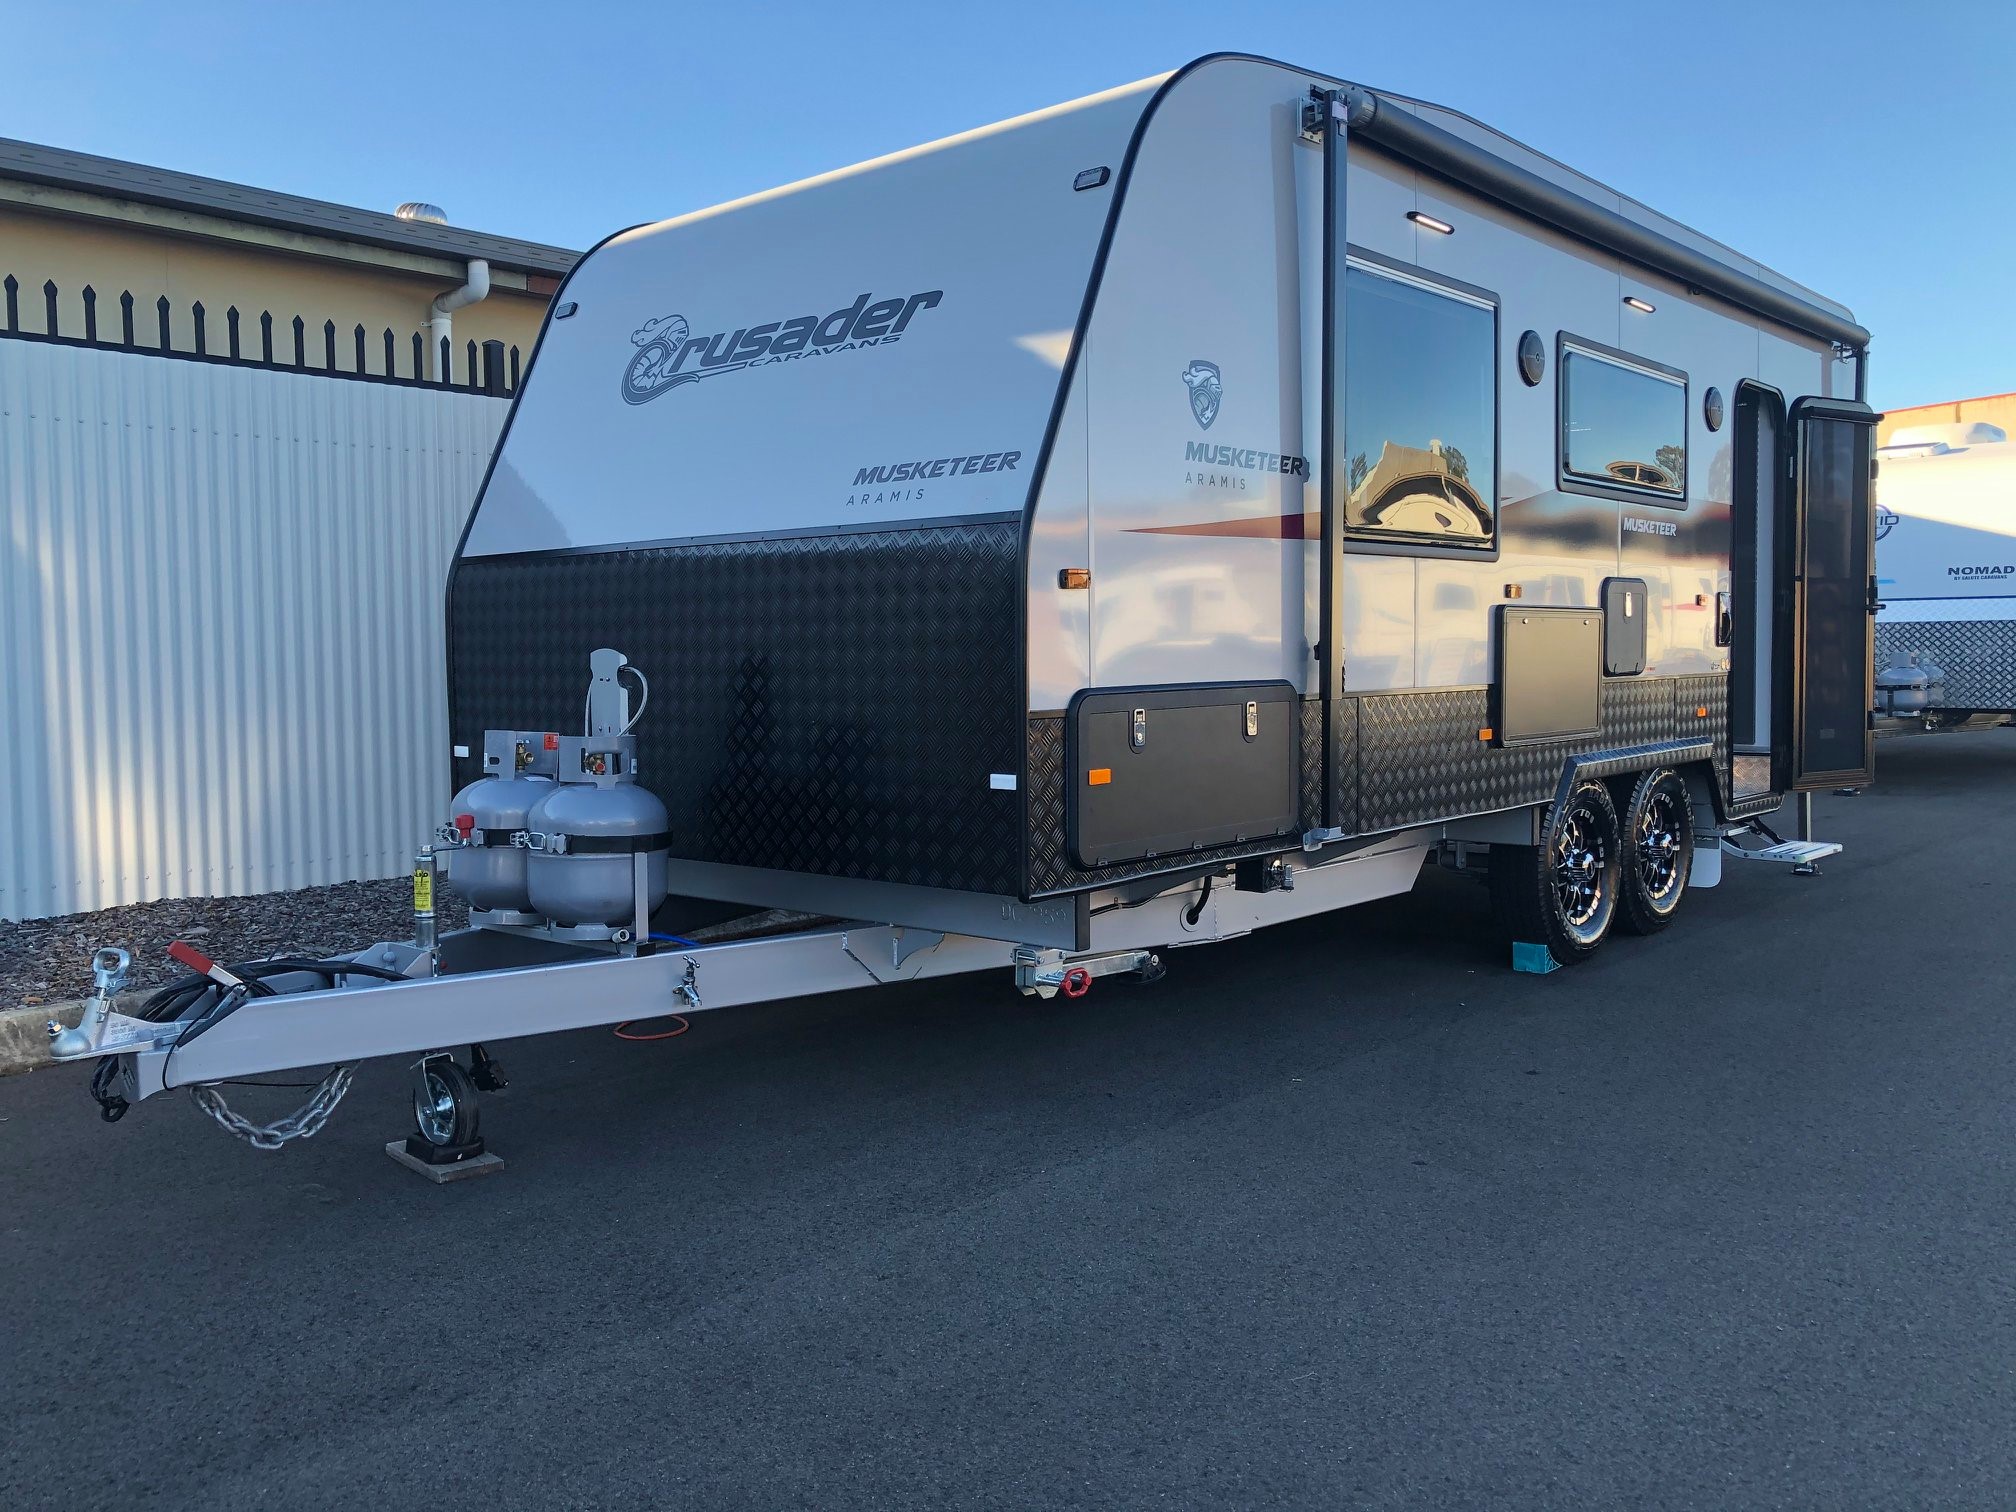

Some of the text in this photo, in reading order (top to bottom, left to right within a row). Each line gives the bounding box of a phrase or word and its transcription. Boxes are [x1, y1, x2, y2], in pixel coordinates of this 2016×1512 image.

[745, 334, 902, 368] CARAVANS
[1185, 441, 1303, 475] MUSKETEER
[853, 451, 1022, 486] MUSKETEER
[1185, 471, 1246, 490] ARAMIS
[846, 488, 925, 506] ARAMIS
[1623, 517, 1677, 537] MUSKETEER
[1947, 565, 2016, 576] NOMAD
